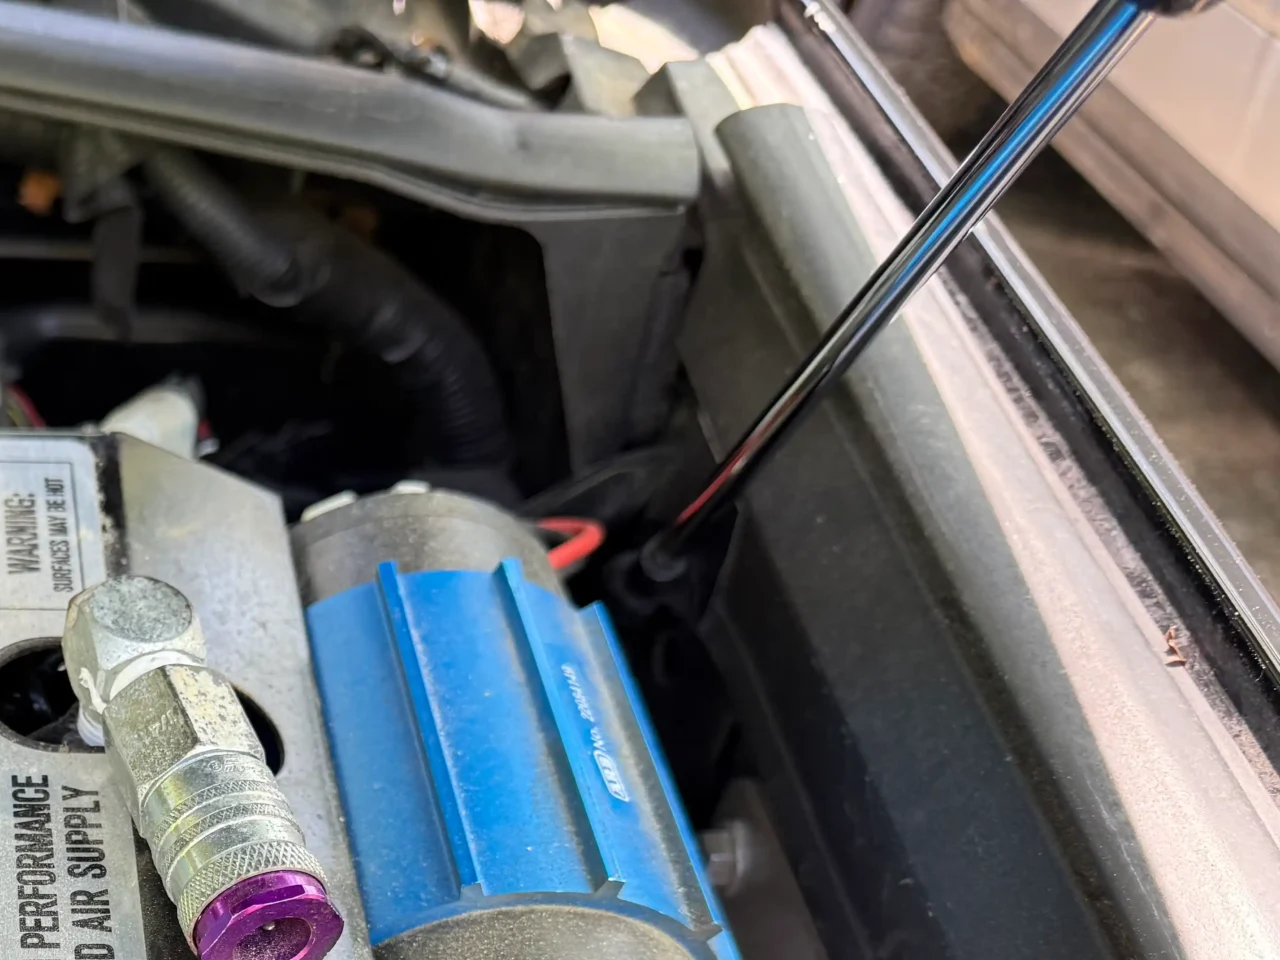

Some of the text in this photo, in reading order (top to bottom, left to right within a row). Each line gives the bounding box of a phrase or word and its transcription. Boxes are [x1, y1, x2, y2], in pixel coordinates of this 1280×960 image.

[4, 492, 42, 576] WARNING:
[44, 477, 75, 593] SURFACES MAY BE HOT
[11, 774, 61, 949] PERFORMANCE
[61, 785, 108, 879] SUPPLY
[69, 888, 113, 932] AIR
